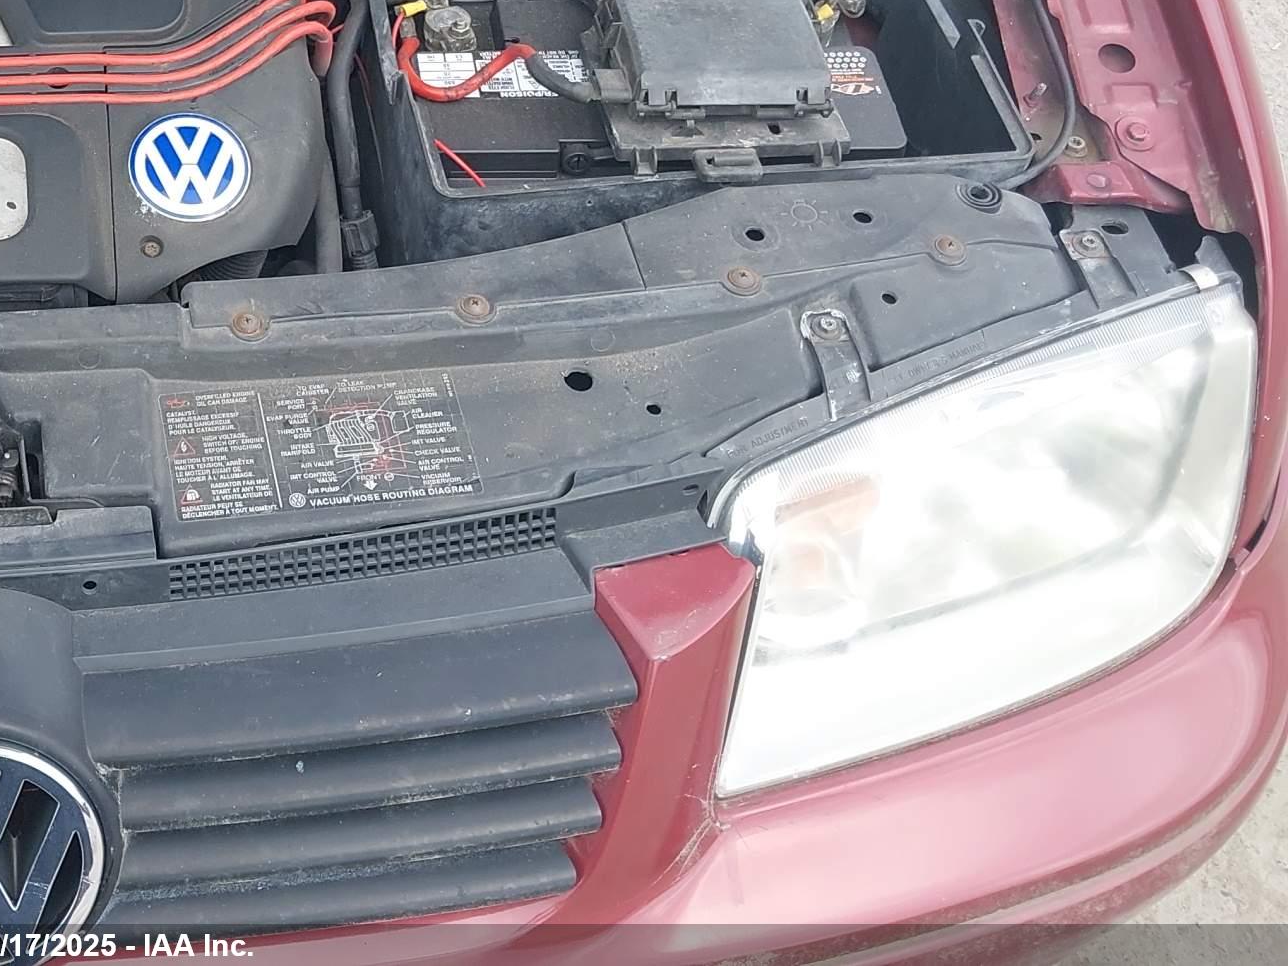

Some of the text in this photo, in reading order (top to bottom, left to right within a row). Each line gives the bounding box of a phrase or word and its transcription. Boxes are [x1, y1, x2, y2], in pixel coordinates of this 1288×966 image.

[167, 415, 209, 424] REMPLISSAGE
[416, 422, 450, 430] PRESSURE
[277, 427, 312, 435] THROTTLE
[416, 426, 457, 435] REGULATOR
[423, 477, 462, 485] RESERVOIR
[309, 484, 472, 507] VACUUM HOSE ROUTING DIAGRAM
[181, 504, 216, 512] RADIATEUR
[182, 510, 224, 519] DÉCLENCHER
